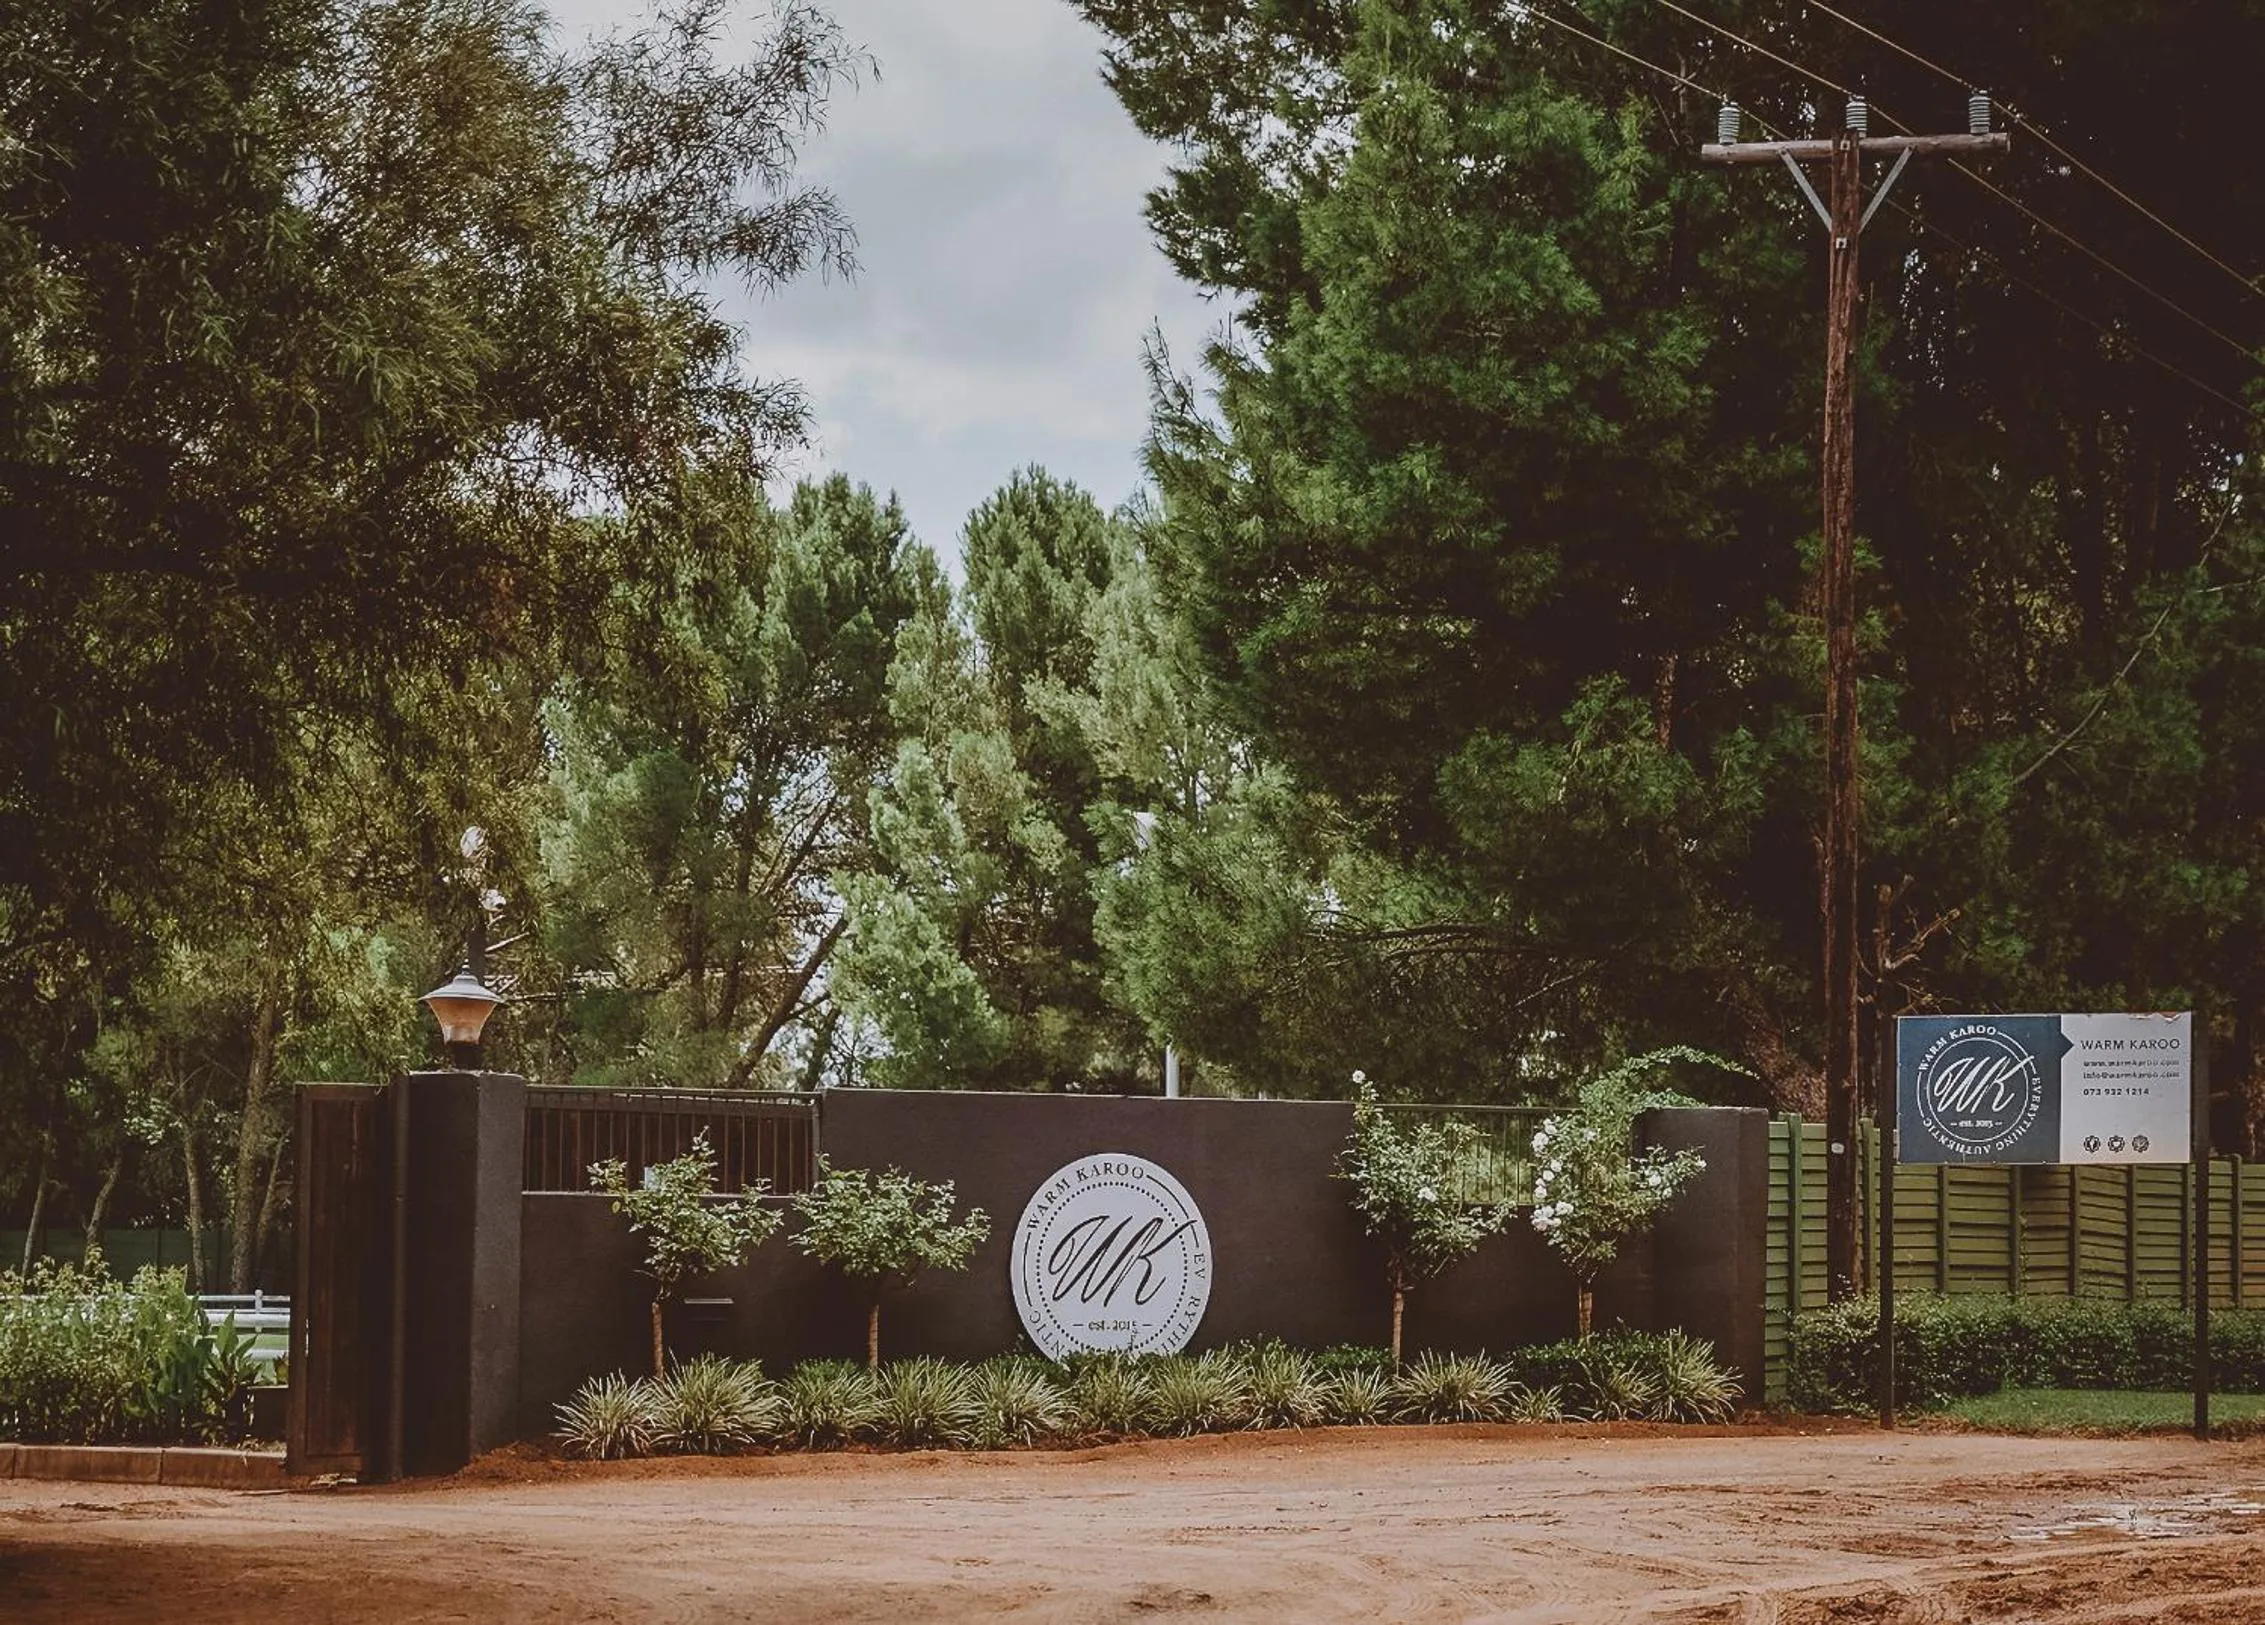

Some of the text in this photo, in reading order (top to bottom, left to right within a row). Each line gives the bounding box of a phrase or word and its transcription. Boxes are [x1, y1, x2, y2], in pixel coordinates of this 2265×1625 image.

[1918, 1025, 1997, 1071] WARM KAROO
[2081, 1038, 2181, 1050] WARM KAROO
[1922, 1076, 2042, 1155] EVERYTHING AUTHENTIC
[1933, 1055, 2035, 1114] WK
[1027, 1162, 1144, 1230] WARM KAROO
[1048, 1214, 1198, 1308] WK
[1161, 1253, 1206, 1354] EVRYTHI
